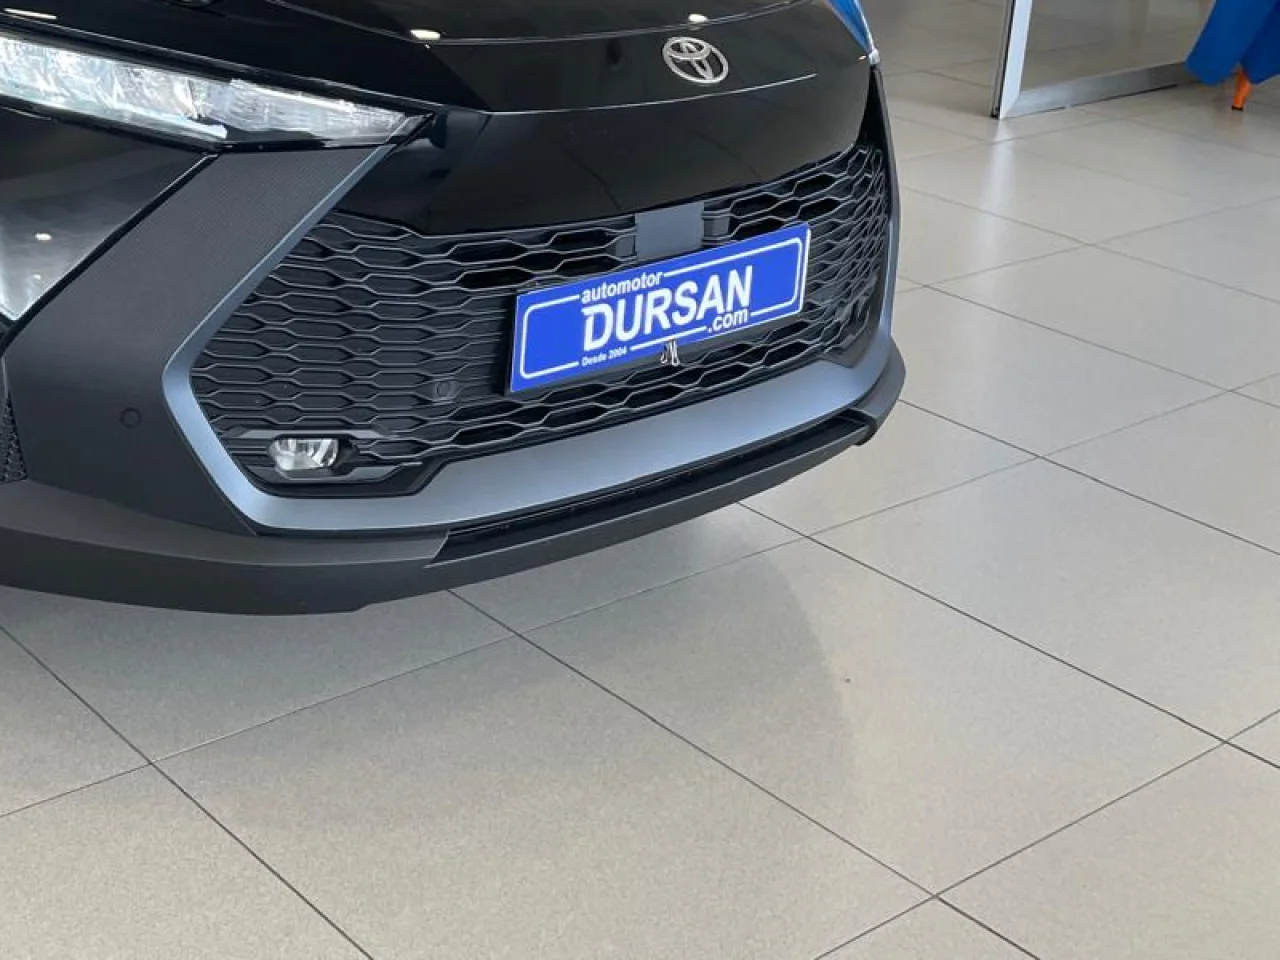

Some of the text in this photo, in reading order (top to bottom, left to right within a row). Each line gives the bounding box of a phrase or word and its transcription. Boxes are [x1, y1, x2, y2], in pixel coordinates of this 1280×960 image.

[581, 271, 664, 304] automotor
[581, 265, 753, 351] DURSAN
[707, 308, 749, 333] .com
[581, 352, 607, 366] Desde
